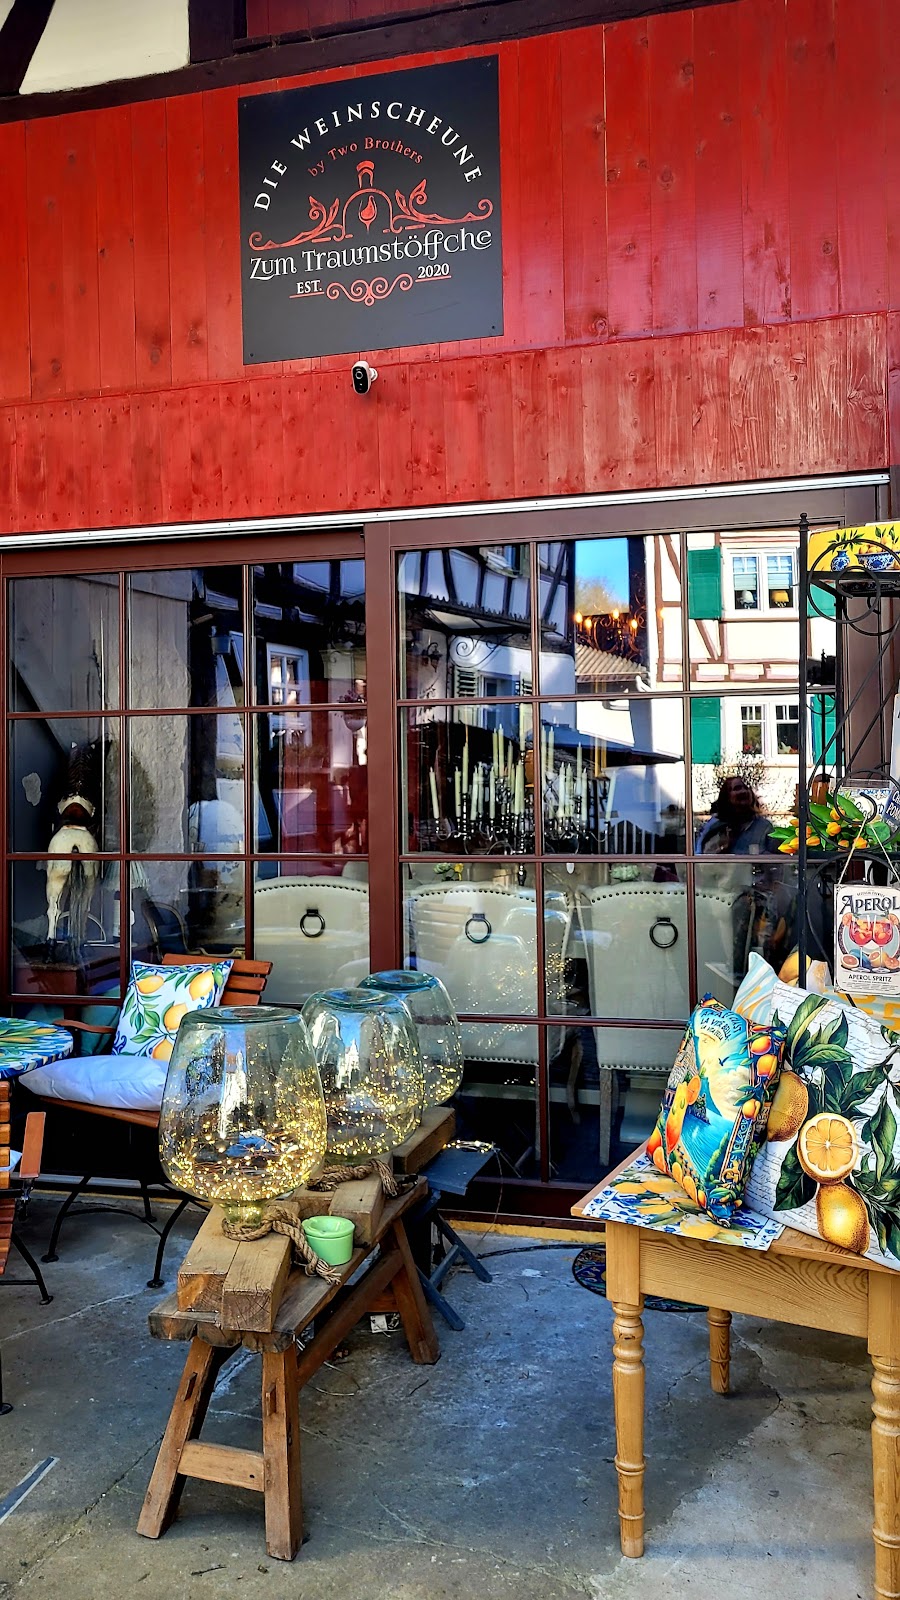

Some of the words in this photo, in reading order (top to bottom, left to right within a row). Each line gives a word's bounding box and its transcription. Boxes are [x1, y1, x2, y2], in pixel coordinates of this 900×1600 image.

[253, 160, 288, 212] DIE
[290, 101, 482, 183] WEINSCHEUNE
[308, 160, 326, 178] by
[327, 143, 358, 161] Two
[364, 137, 424, 165] Brothers
[249, 256, 297, 281] Zum
[301, 228, 492, 273] Traumstöffche
[296, 280, 323, 294] EST.
[417, 263, 450, 279] 2020
[839, 895, 900, 915] APEROL
